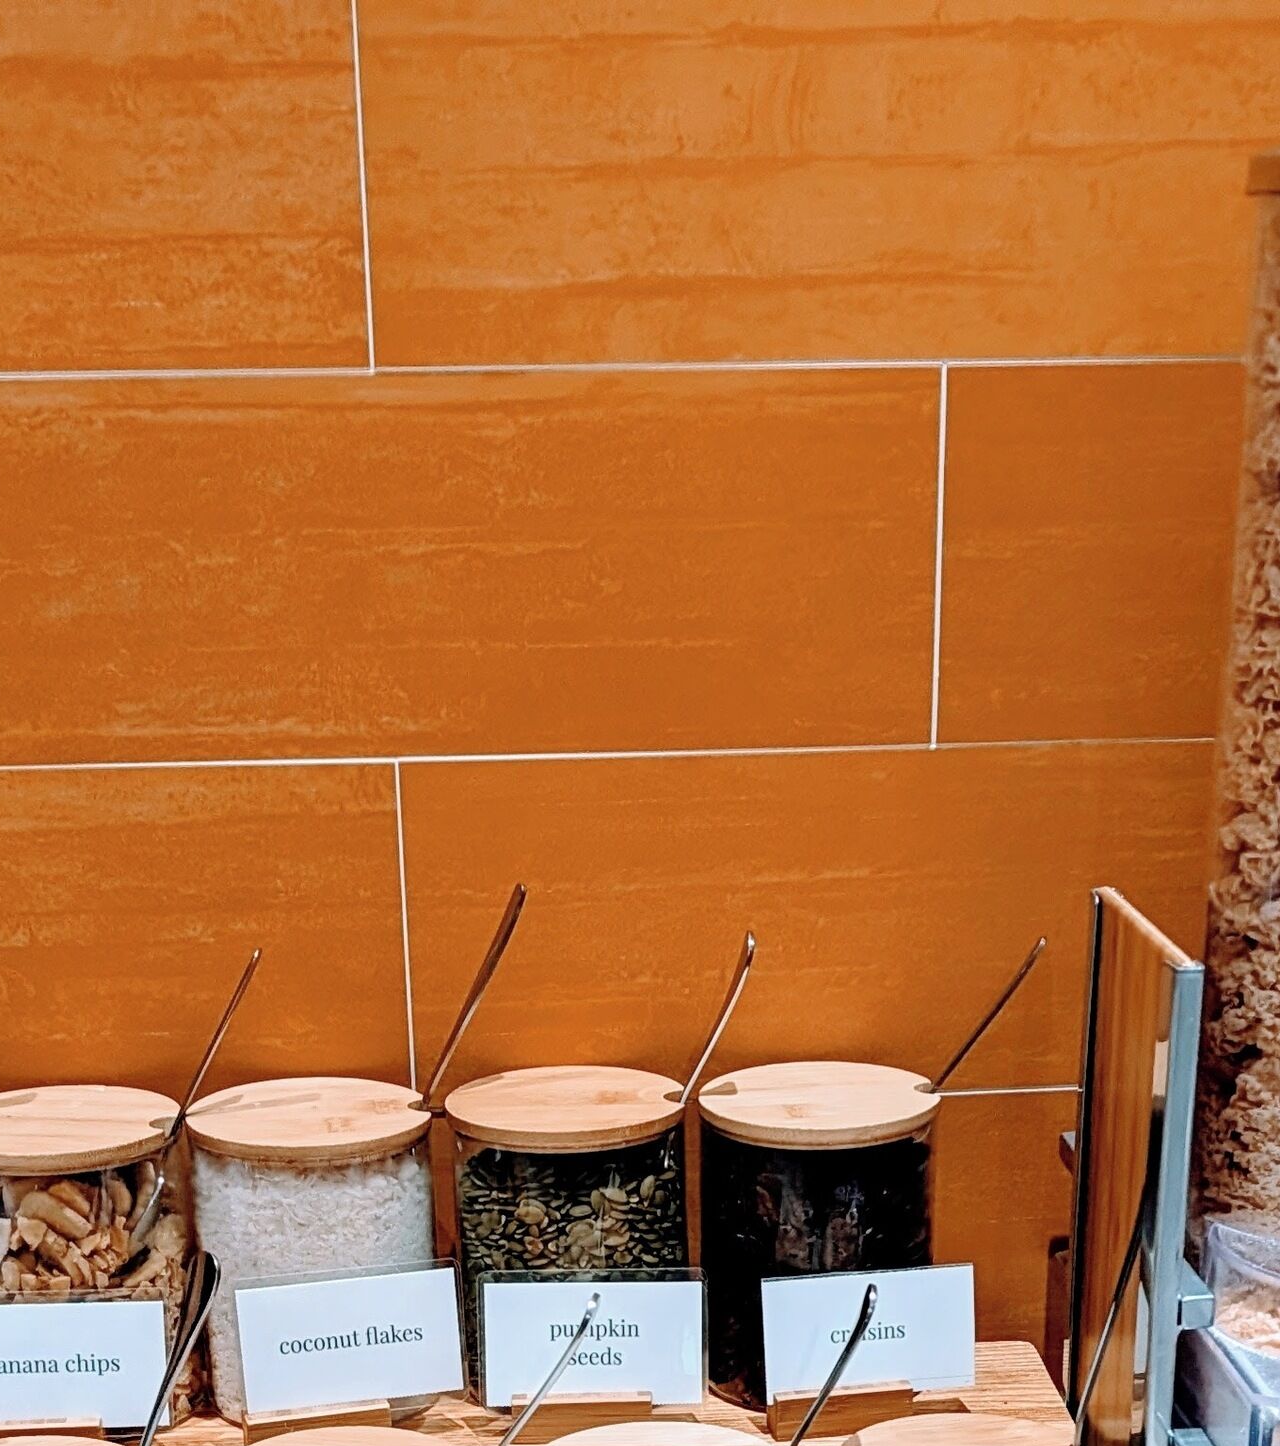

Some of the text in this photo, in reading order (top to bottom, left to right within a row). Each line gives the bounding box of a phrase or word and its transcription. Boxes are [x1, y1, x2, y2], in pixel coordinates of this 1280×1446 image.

[279, 1324, 423, 1355] coconut flakes
[65, 1353, 121, 1376] chips
[568, 1347, 623, 1366] seeds
